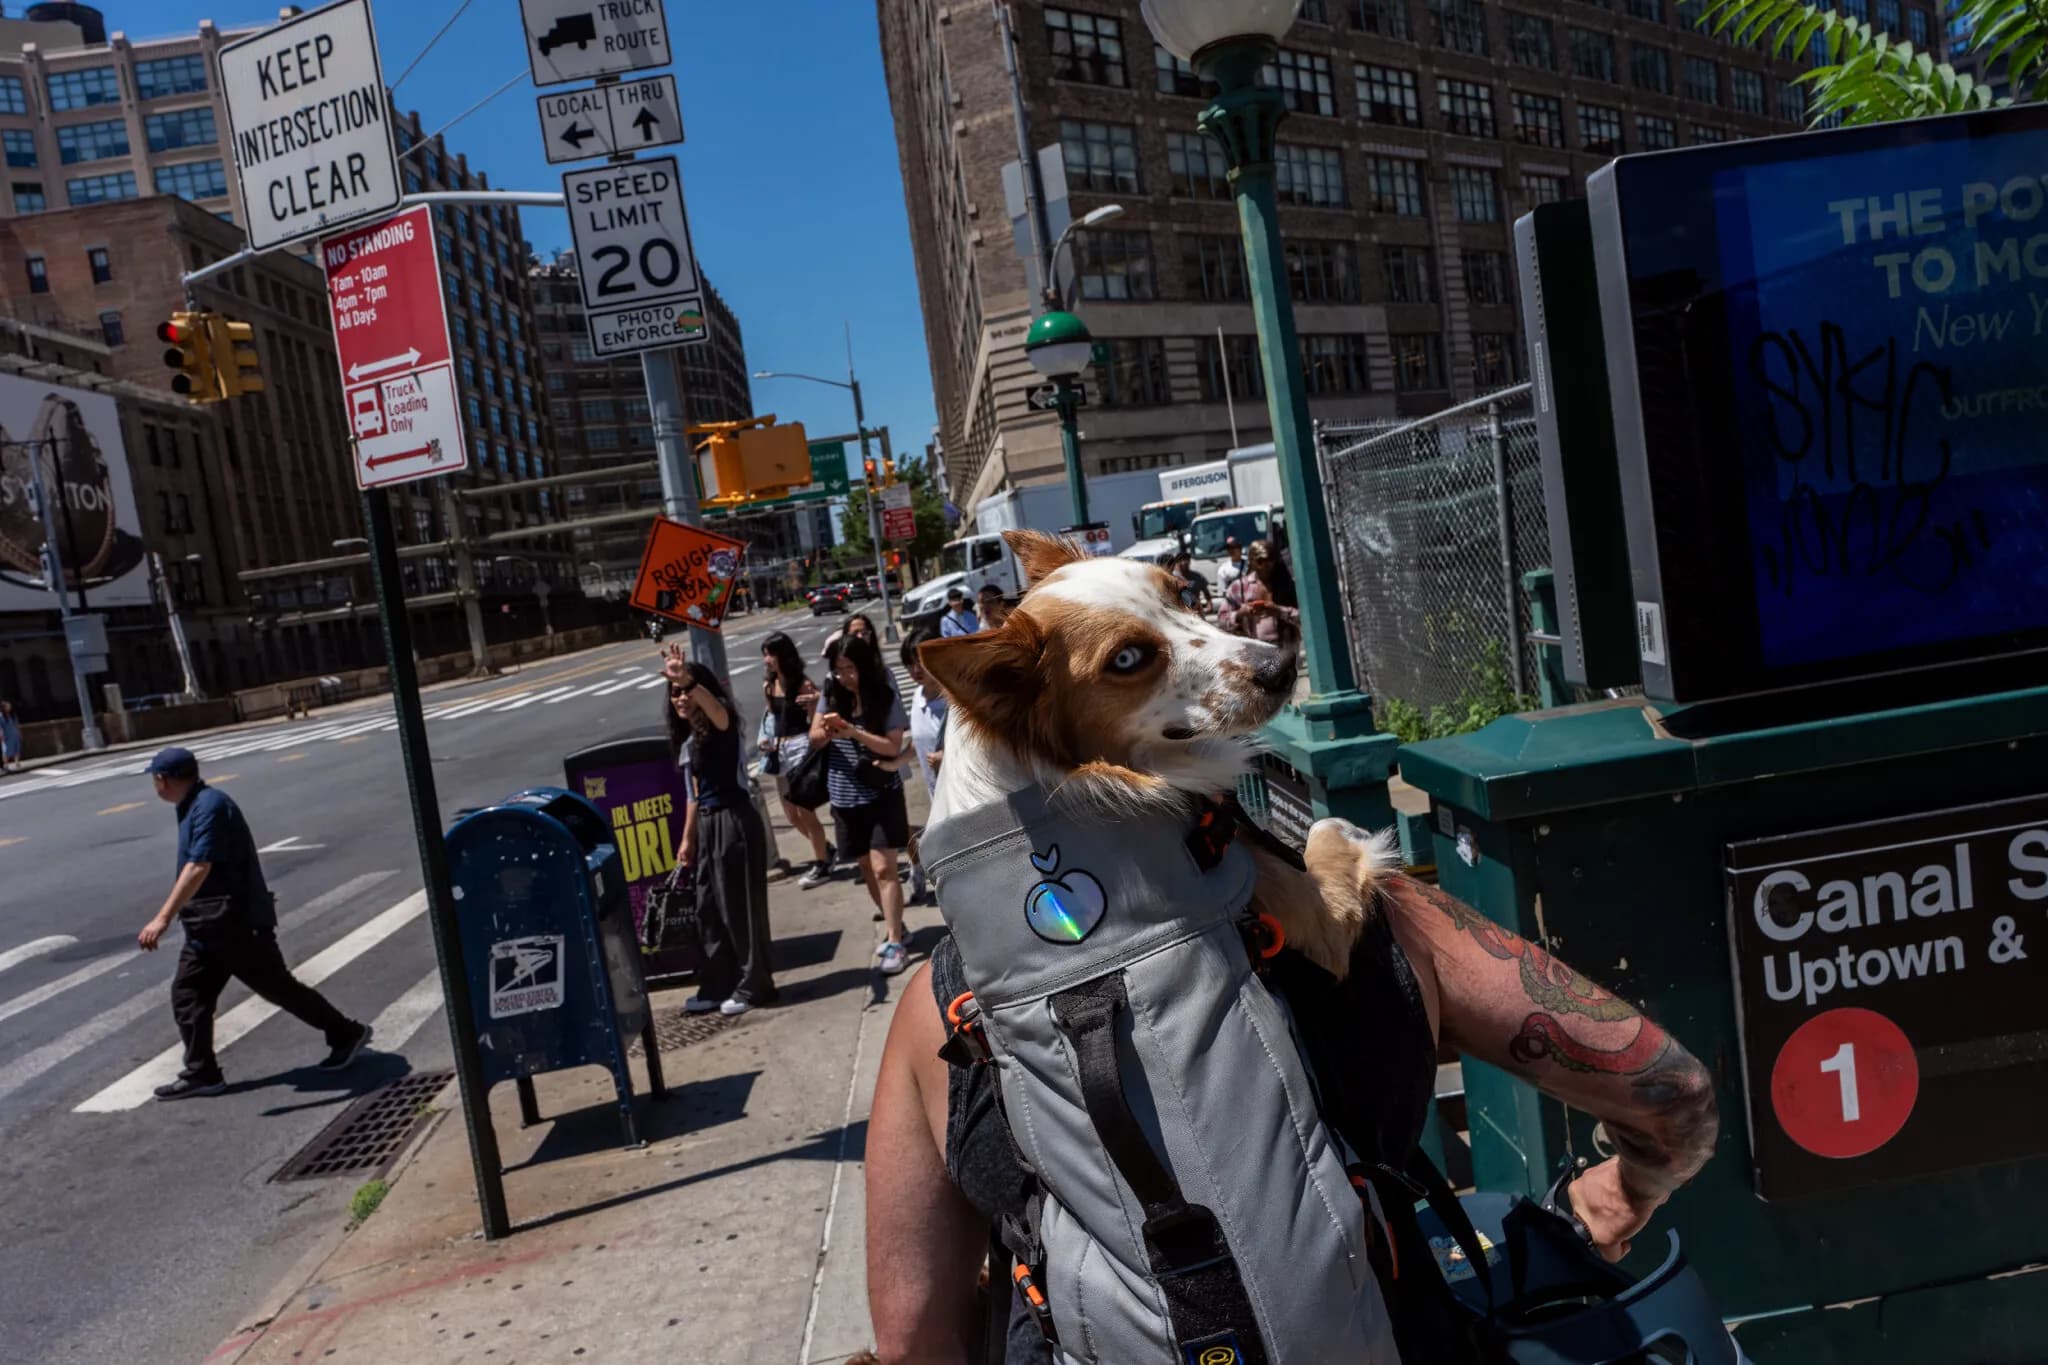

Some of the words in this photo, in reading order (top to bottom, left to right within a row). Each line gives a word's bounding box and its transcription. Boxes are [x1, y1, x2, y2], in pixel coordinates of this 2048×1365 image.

[598, 0, 655, 21] TRUCK
[604, 28, 661, 53] ROUTE
[257, 34, 333, 100] KEEP
[546, 93, 603, 118] LOCAL
[616, 82, 664, 105] THRU
[239, 84, 380, 168] INTERSECTION
[269, 152, 369, 221] CLEAR
[576, 171, 669, 203] SPEED
[590, 201, 663, 232] LIMIT
[1828, 188, 1946, 244] THE
[327, 244, 346, 266] NO
[349, 221, 414, 260] STANDING
[331, 275, 354, 292] 7am
[360, 264, 388, 283] 10am
[591, 238, 680, 297] 20
[1874, 247, 1956, 298] TO
[336, 294, 358, 312] 4pm
[364, 285, 388, 304] 7pm
[339, 312, 352, 330] All
[352, 307, 377, 326] Days
[617, 307, 674, 328] PHOTO
[1912, 303, 2014, 352] New
[602, 321, 690, 347] ENFORCE
[386, 380, 415, 399] Truck
[388, 397, 428, 416] Loading
[391, 416, 413, 432] Only
[1179, 471, 1228, 488] FERGUSON
[651, 544, 714, 586] ROUGH
[611, 804, 632, 827] IRL
[633, 793, 673, 822] MEETS
[614, 816, 678, 882] URL
[1754, 842, 1974, 942] Canal
[1763, 935, 1965, 1006] Uptown
[1988, 915, 2029, 964] &
[1820, 1042, 1860, 1122] 1
